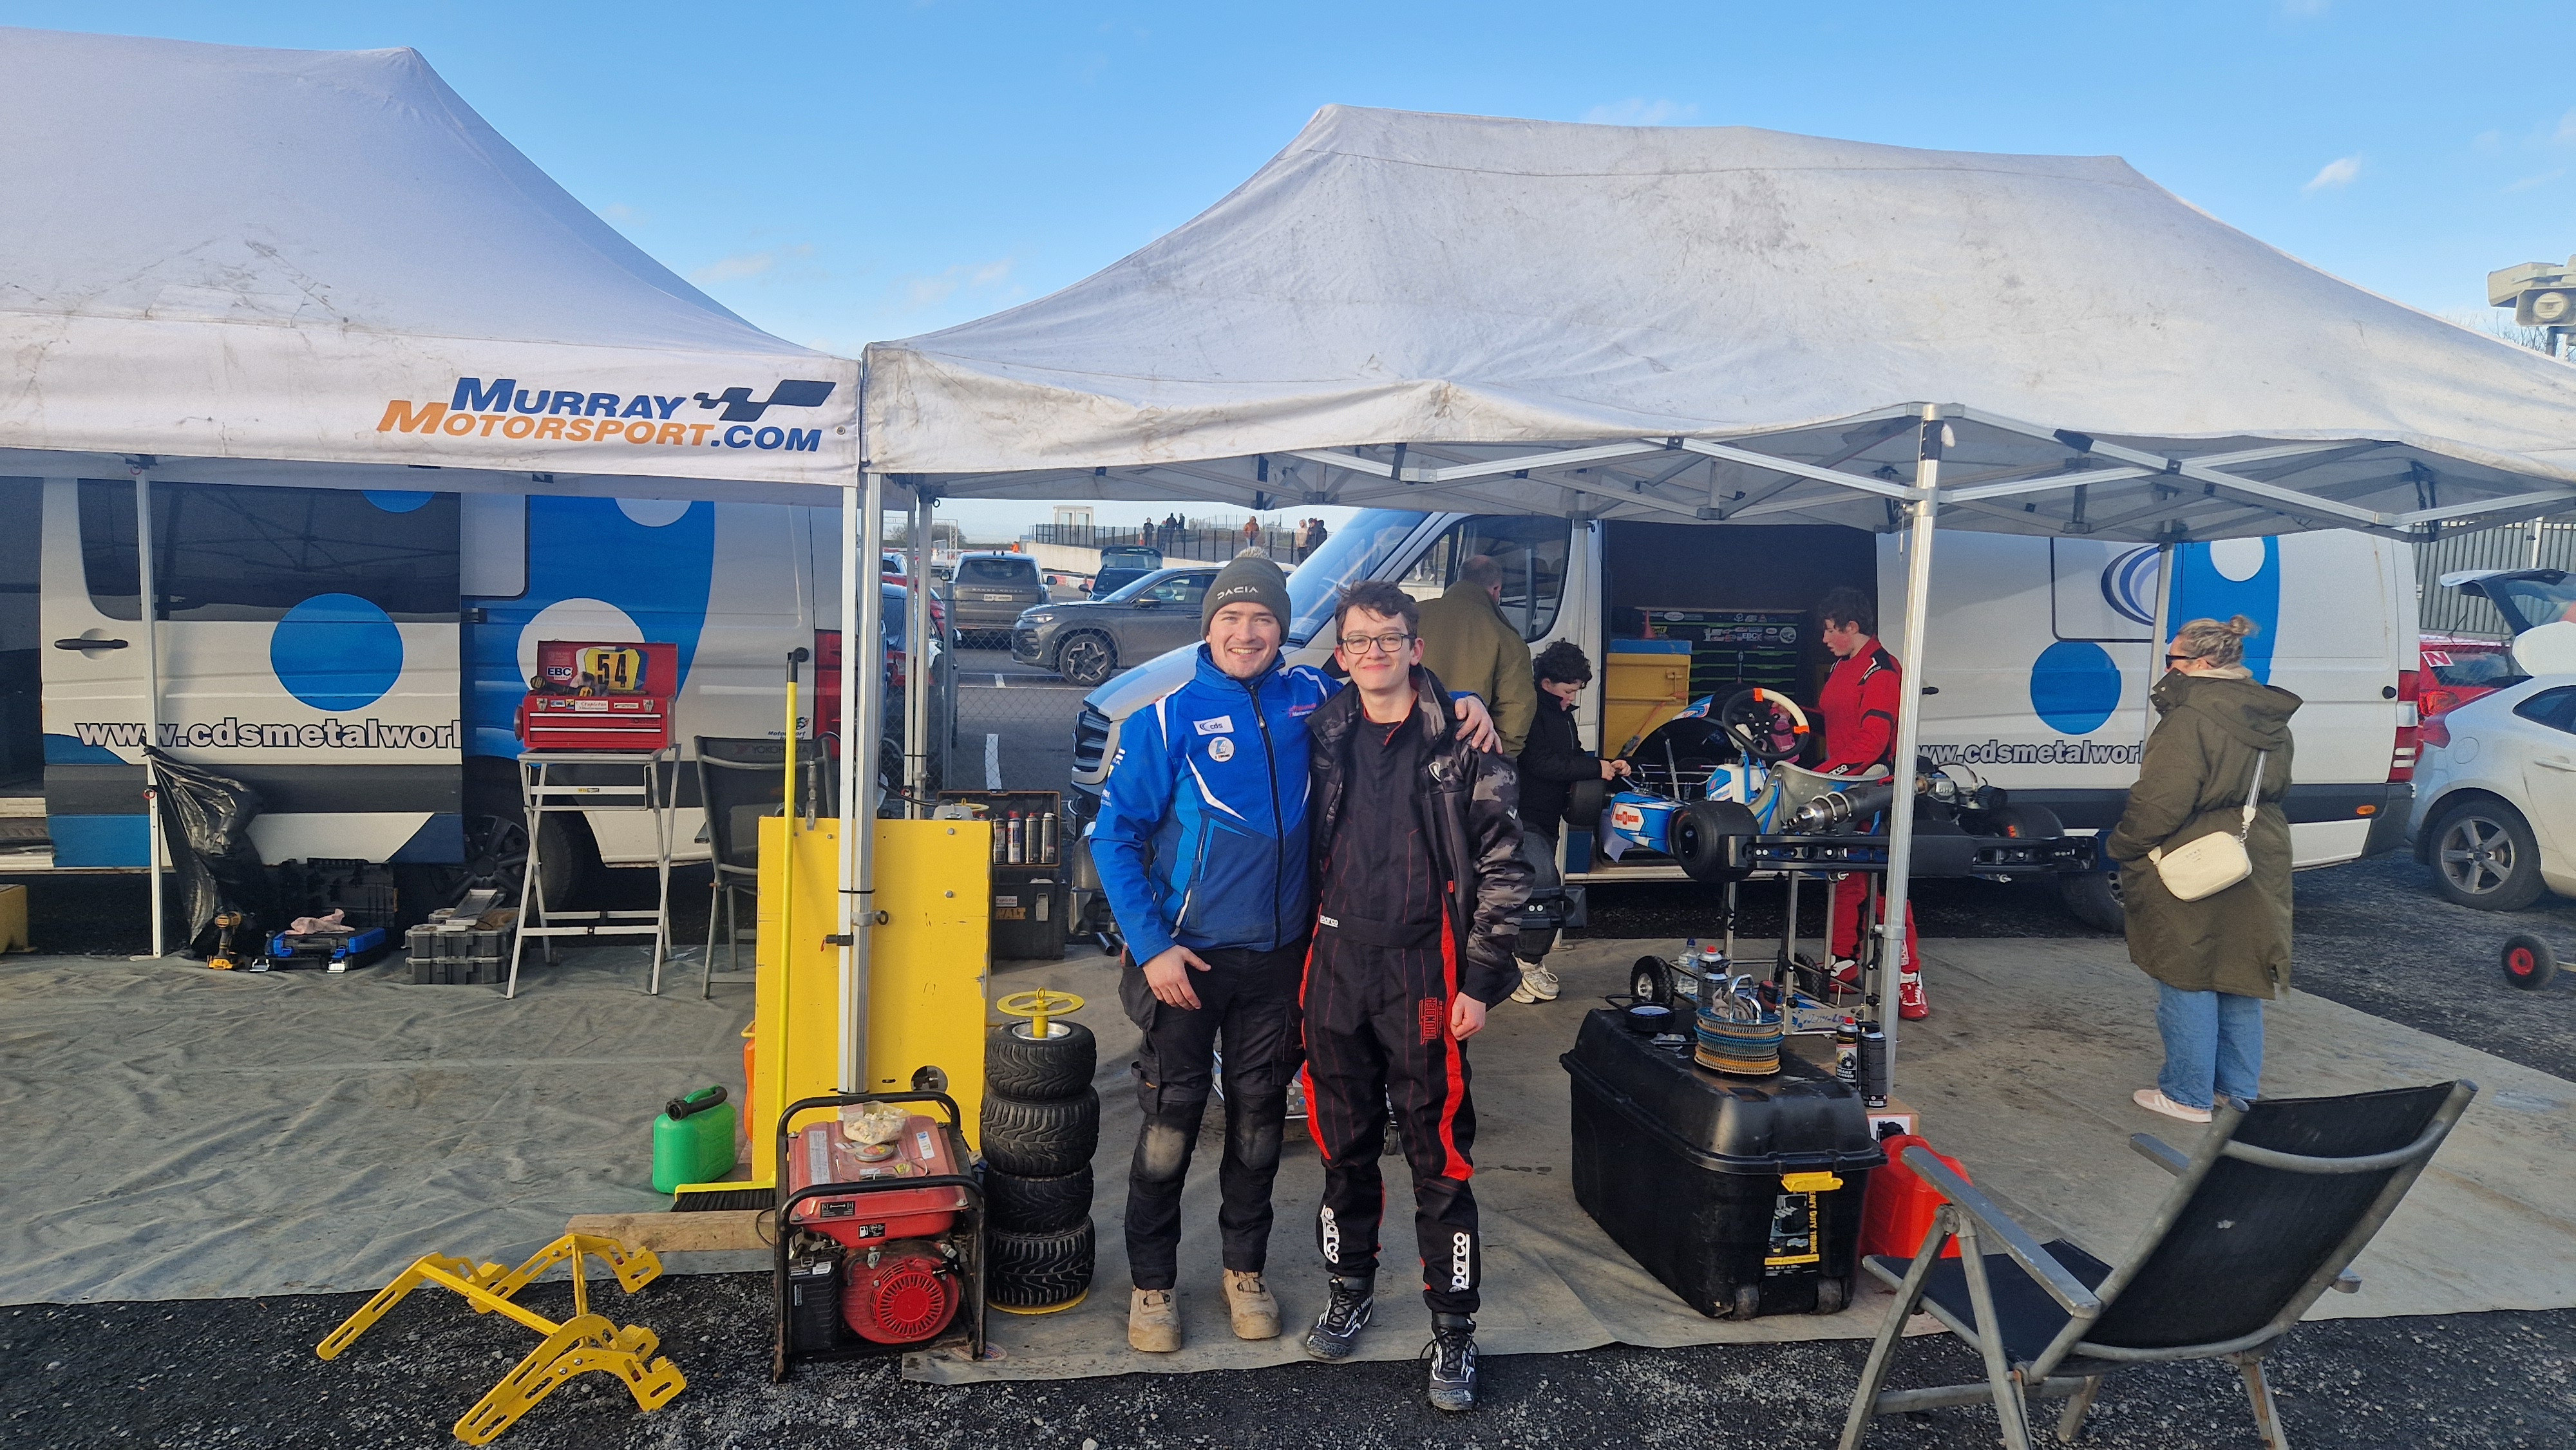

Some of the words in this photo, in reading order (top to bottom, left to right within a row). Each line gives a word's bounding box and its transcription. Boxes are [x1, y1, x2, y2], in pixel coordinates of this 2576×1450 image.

[451, 377, 687, 420] MURRAY
[376, 400, 822, 452] MOTORSPORT.COM
[1217, 586, 1259, 600] DACIA
[547, 668, 571, 676] EBC
[598, 654, 627, 688] 54
[2425, 652, 2451, 665] N
[1421, 997, 1437, 1044] THUNDER
